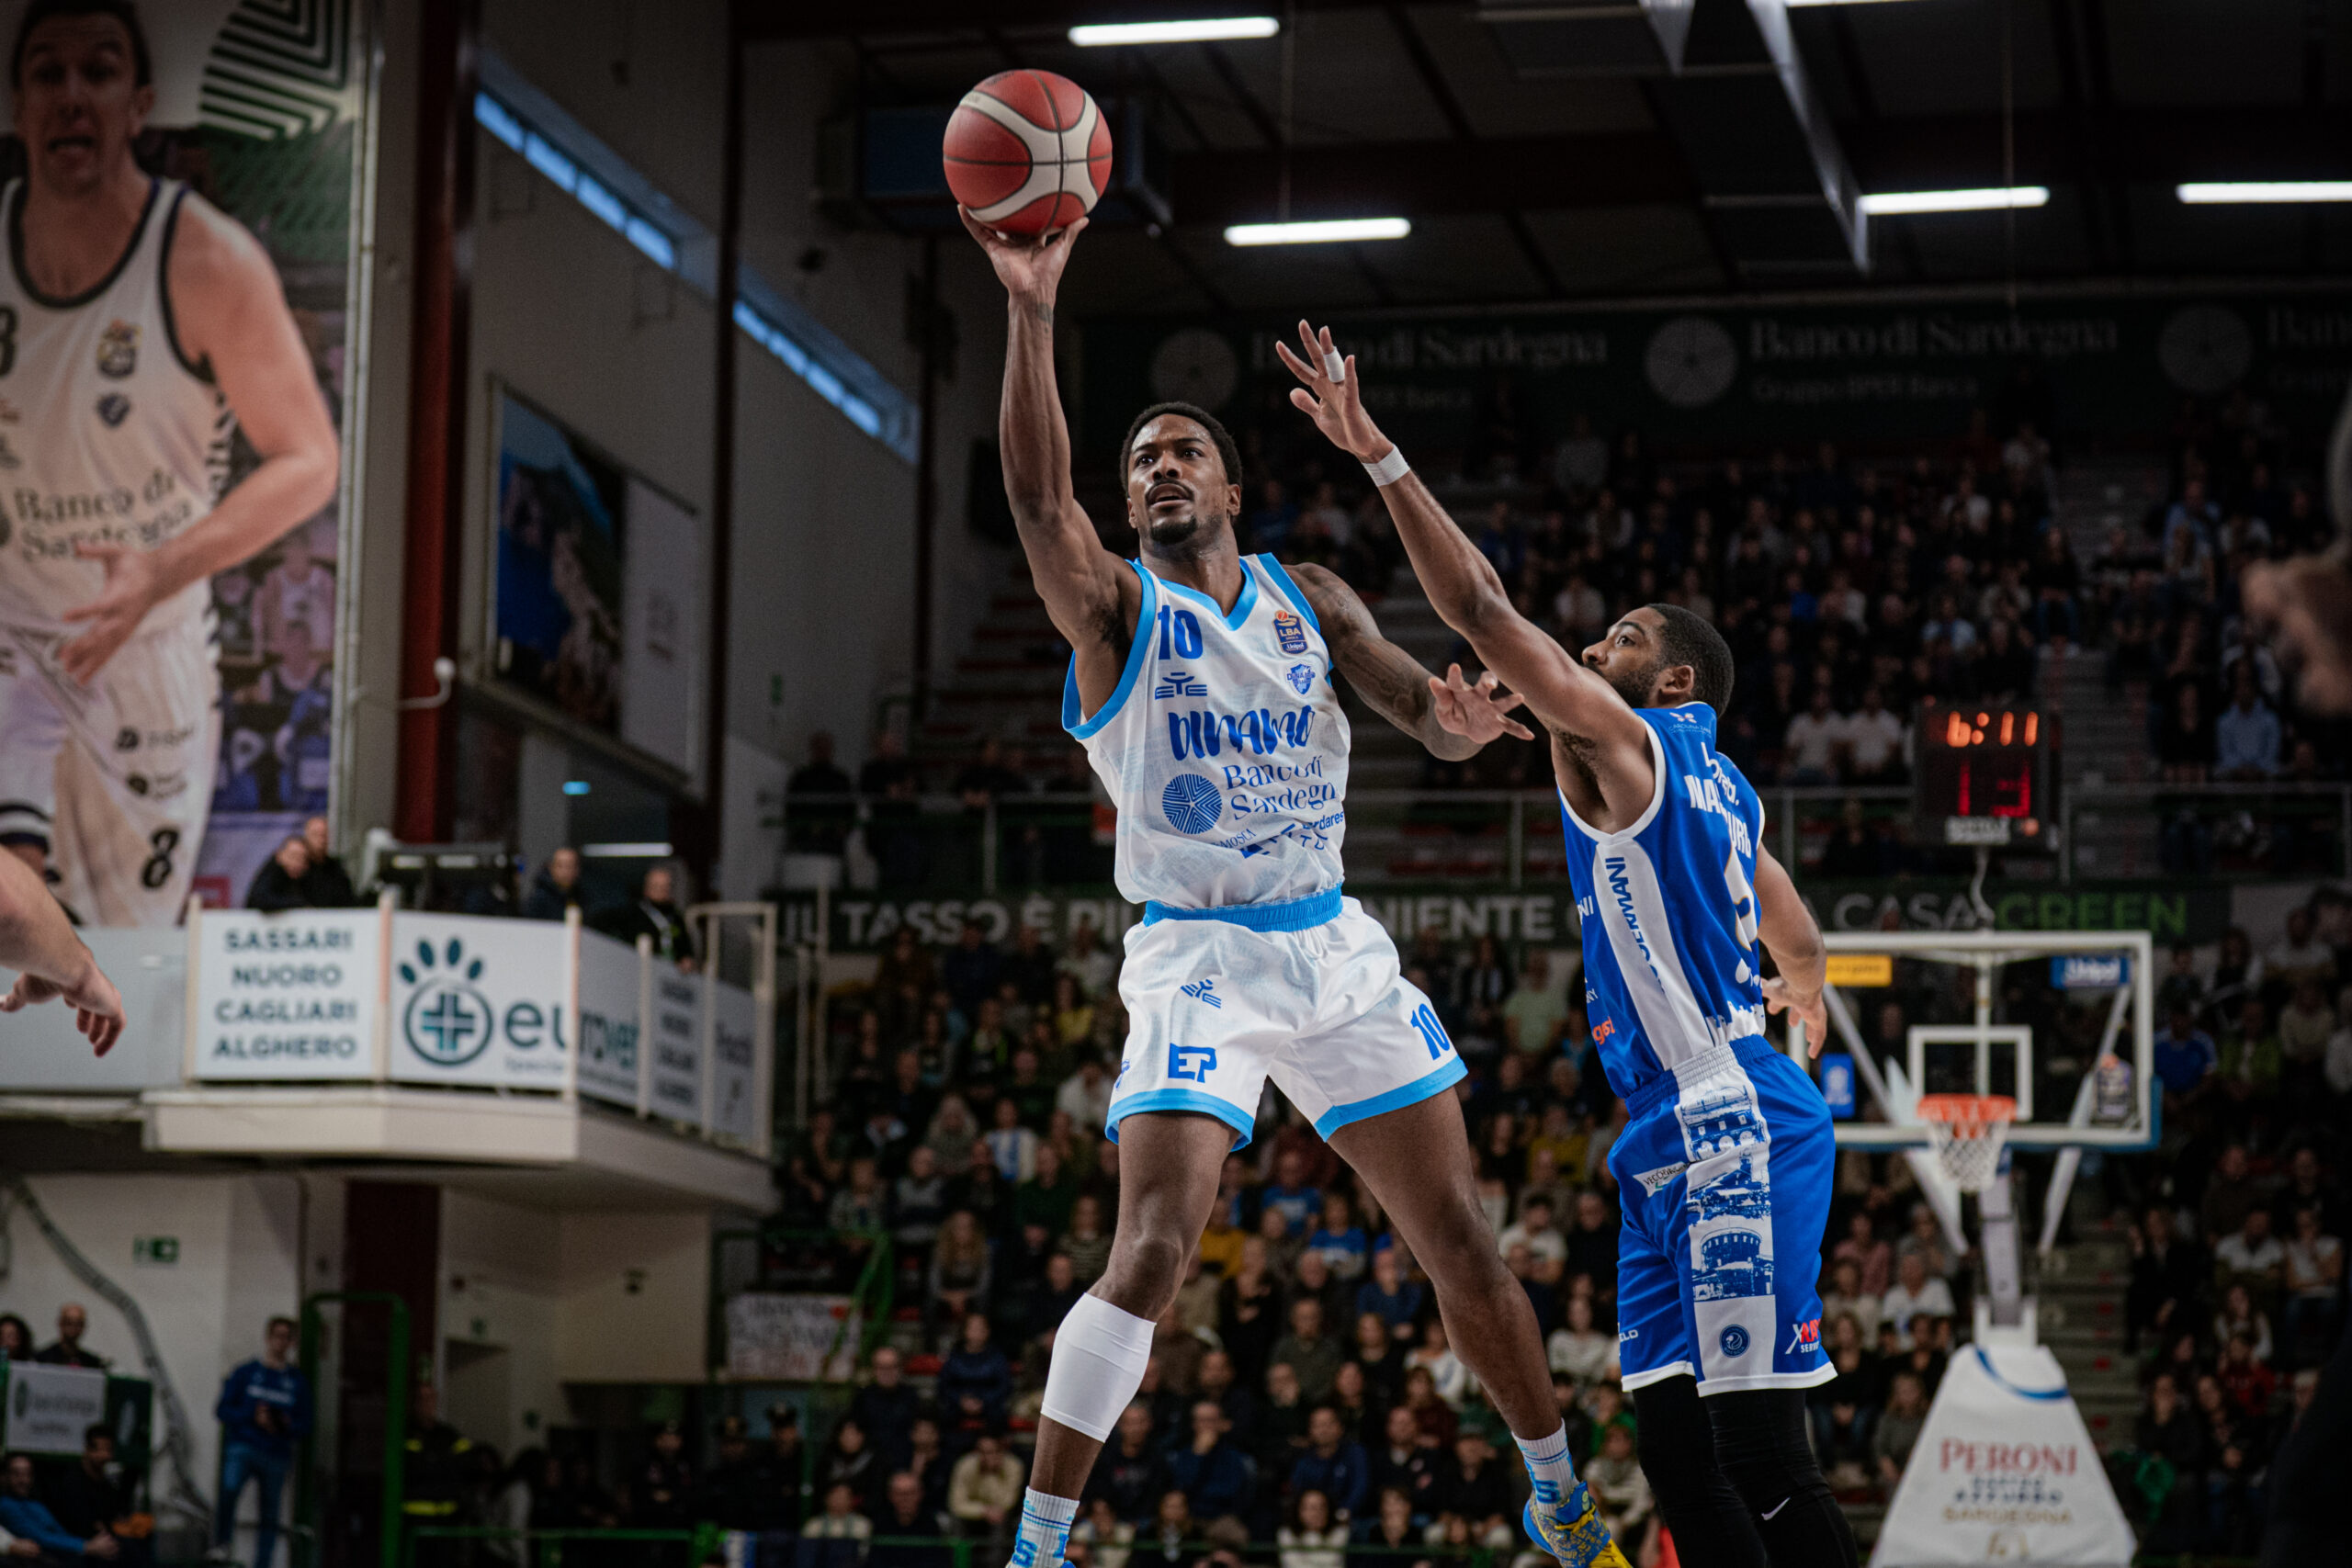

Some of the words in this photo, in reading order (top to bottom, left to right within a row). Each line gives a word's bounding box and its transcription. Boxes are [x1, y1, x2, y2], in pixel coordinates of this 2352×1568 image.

[14, 487, 135, 521] Banco
[1158, 604, 1204, 660] 10
[1279, 626, 1302, 637] LBA
[1286, 643, 1305, 651] Unipol
[1947, 711, 2039, 748] 6:11
[1230, 782, 1337, 821] Sardegn
[142, 829, 179, 888] 8
[838, 899, 1009, 945] TASSO
[1833, 892, 1975, 932] CASA
[1995, 892, 2187, 935] GREEN
[225, 928, 353, 952] SASSARI
[233, 965, 342, 987] NUORO
[215, 999, 357, 1023] CAGLIARI
[212, 1036, 356, 1060] ALGHERO
[1410, 1003, 1451, 1061] 10
[1939, 1437, 2078, 1476] PERONI
